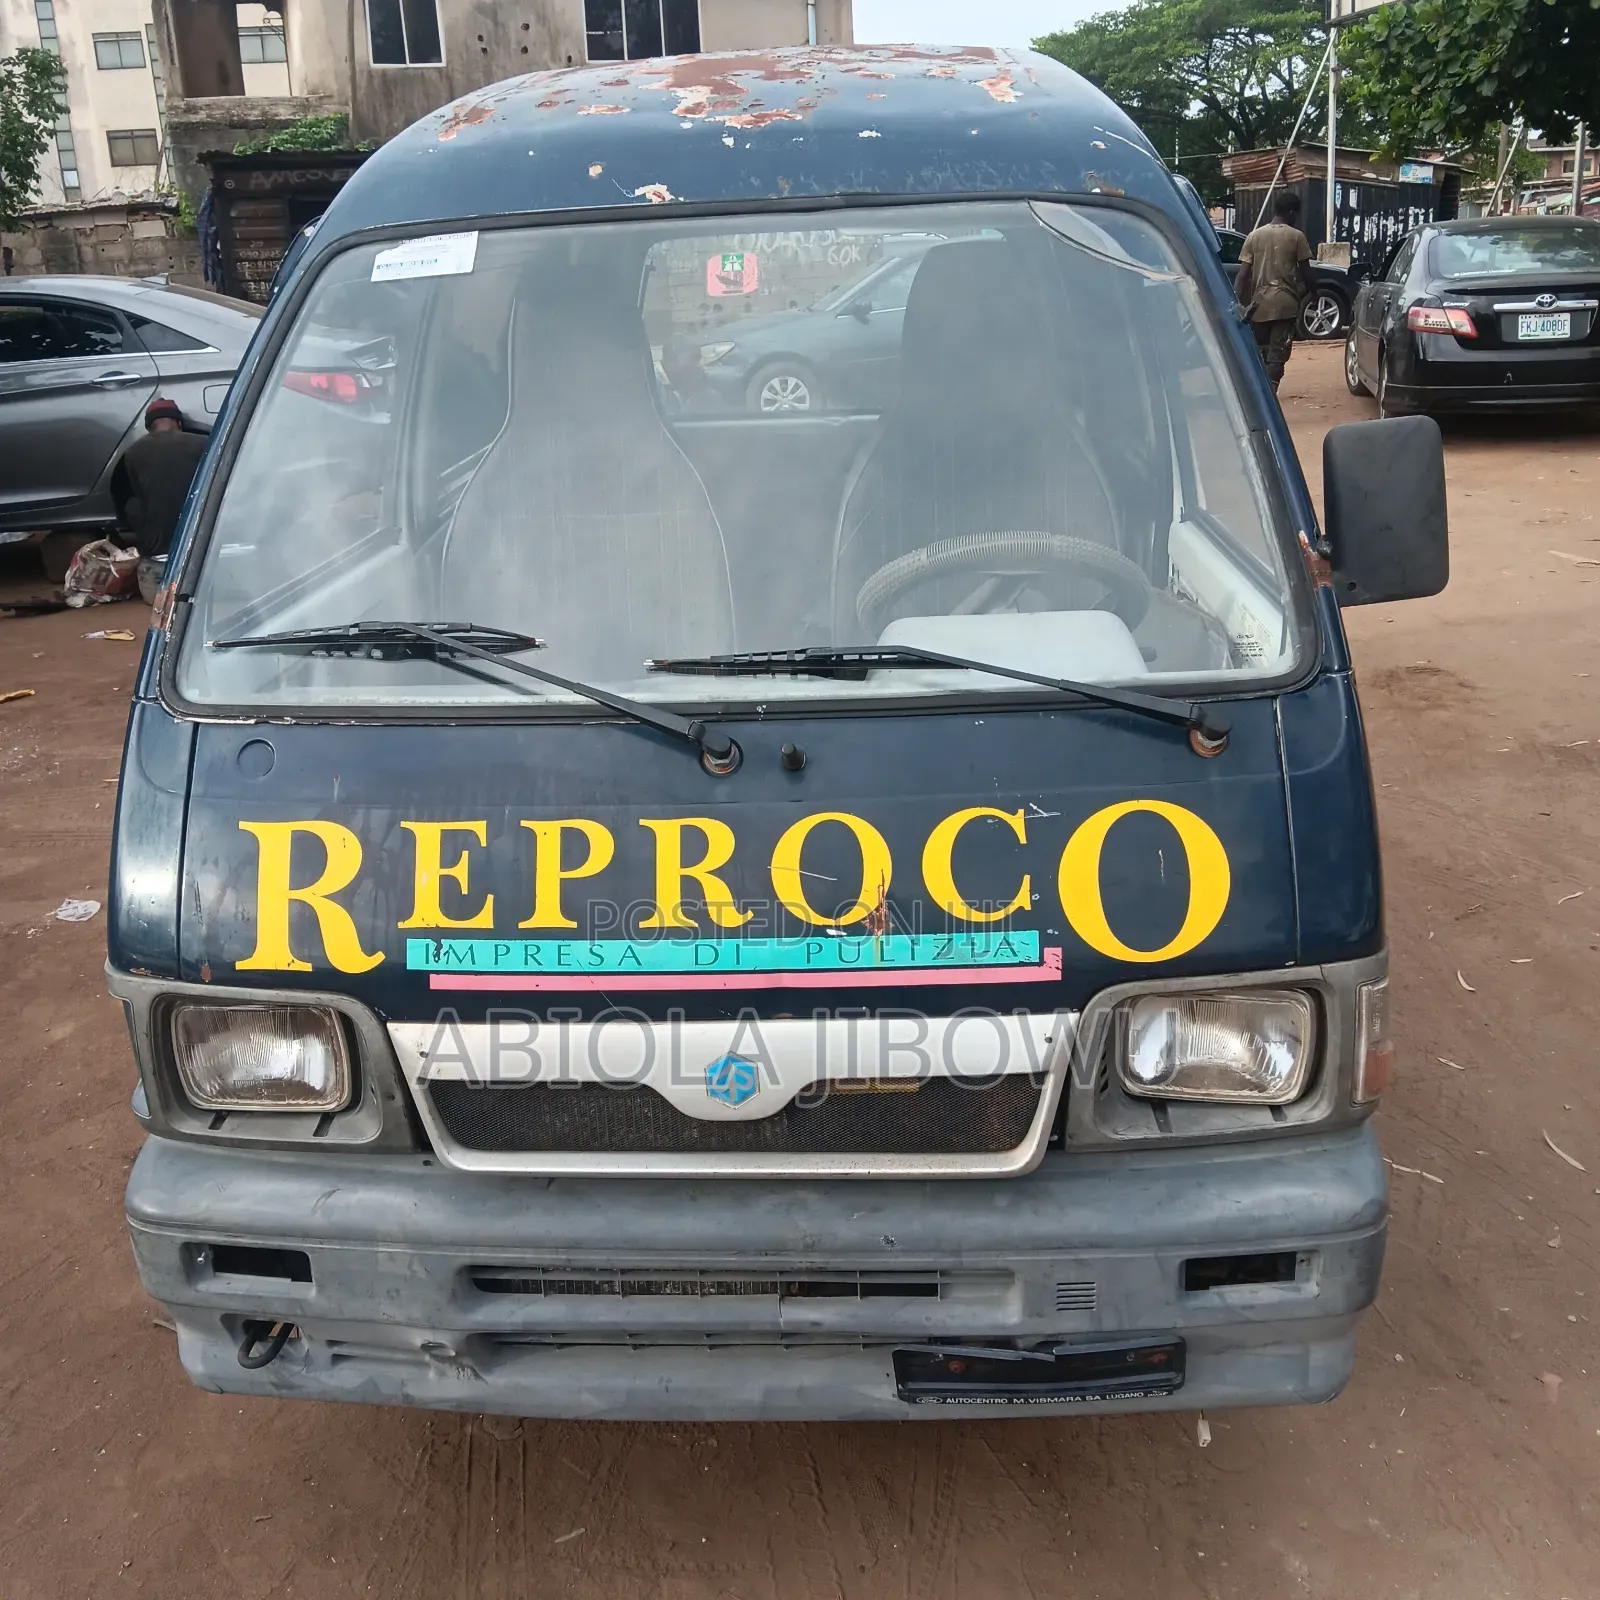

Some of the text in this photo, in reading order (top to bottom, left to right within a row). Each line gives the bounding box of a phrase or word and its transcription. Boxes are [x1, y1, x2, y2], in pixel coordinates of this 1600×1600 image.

[235, 798, 1232, 974] REPROCO
[423, 932, 1021, 967] IMPRESA DI PULIZIA
[1105, 1391, 1144, 1400] LUGANO
